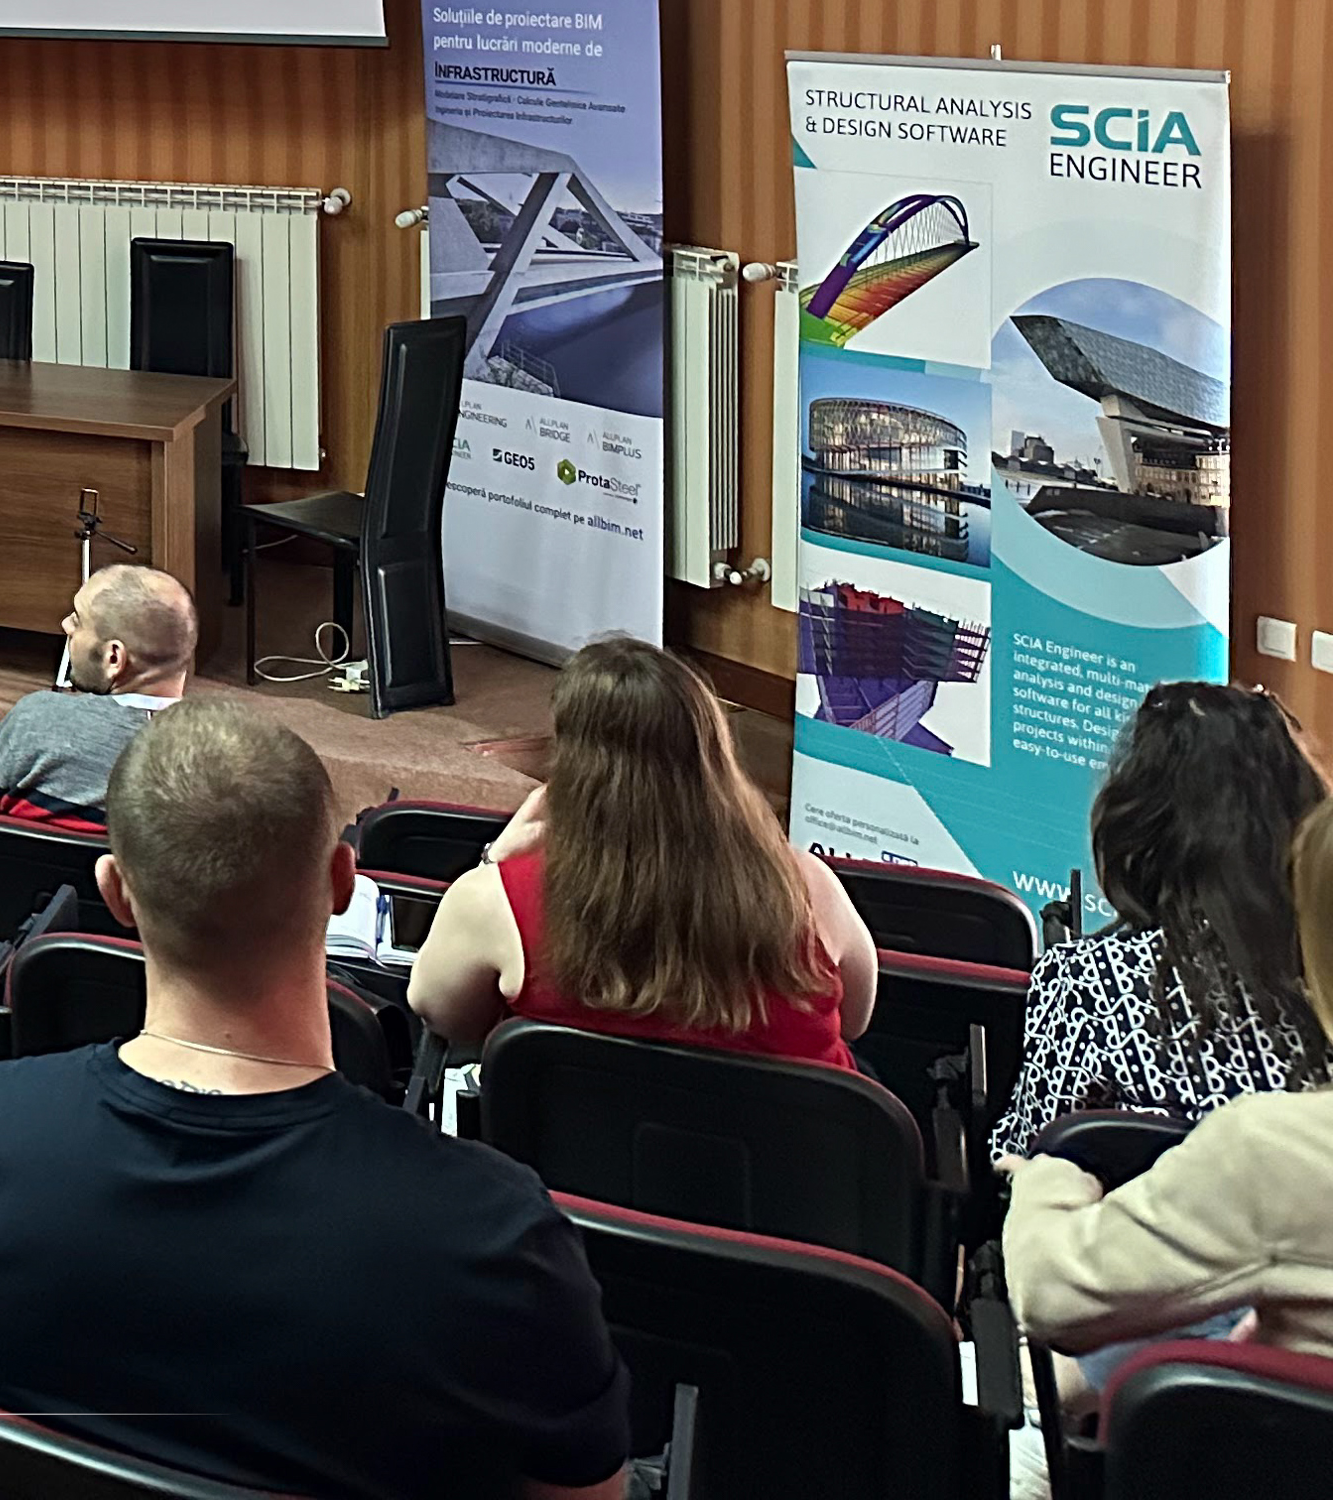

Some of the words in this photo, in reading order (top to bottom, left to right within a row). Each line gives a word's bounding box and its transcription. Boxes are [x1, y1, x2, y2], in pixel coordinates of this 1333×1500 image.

[486, 9, 502, 25] de
[505, 11, 572, 29] proiectare
[575, 14, 603, 30] BIM
[433, 35, 472, 51] pentru
[477, 35, 518, 52] lucrări
[522, 39, 581, 56] moderne
[585, 41, 603, 57] de
[435, 61, 556, 86] INFRASTRUCTURĂ
[806, 89, 930, 114] STRUCTURAL
[935, 97, 1032, 120] ANALYSIS
[806, 117, 818, 133] &
[823, 117, 892, 139] DESIGN
[897, 123, 1007, 147] SOFTWARE
[1050, 152, 1203, 188] ENGINEER
[459, 409, 507, 428] NGINEERING
[540, 426, 571, 443] BRIDGE
[504, 451, 535, 471] GEO5
[602, 442, 642, 459] BIMPLUS
[447, 481, 487, 498] escoperă
[535, 504, 571, 521] complet
[574, 514, 585, 525] pe
[587, 515, 644, 541] allbim.net
[1013, 633, 1043, 651] SCIA
[1046, 640, 1104, 664] Engineer
[1106, 654, 1118, 667] is
[1119, 659, 1136, 674] an
[1013, 650, 1083, 679] integrated,
[1013, 669, 1064, 691] analysis
[1067, 681, 1092, 698] and
[1013, 687, 1069, 710] software
[1072, 699, 1091, 715] for
[1094, 705, 1111, 720] all
[1013, 704, 1080, 729] structures.
[1013, 721, 1064, 744] projects
[1013, 738, 1085, 767] easy-to-use
